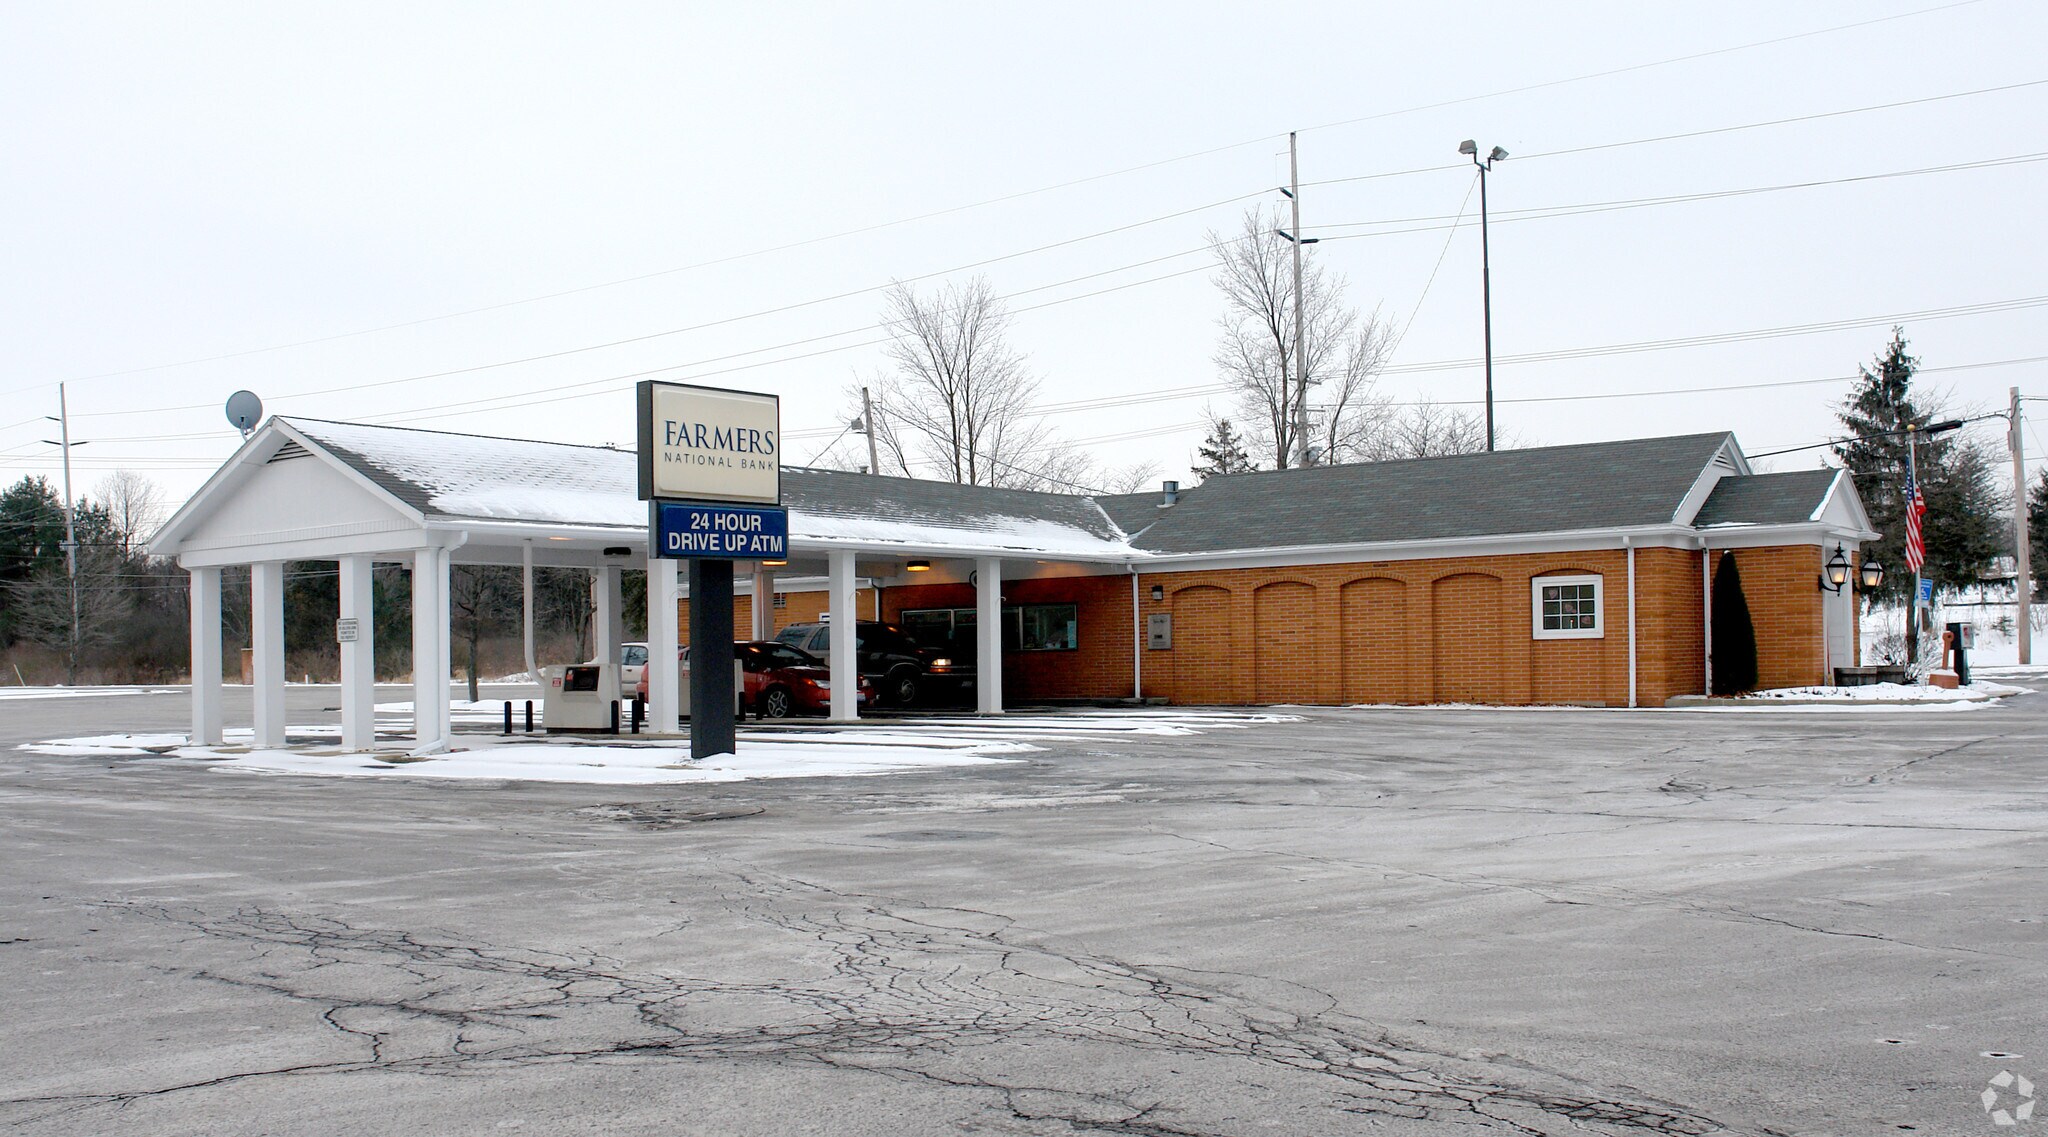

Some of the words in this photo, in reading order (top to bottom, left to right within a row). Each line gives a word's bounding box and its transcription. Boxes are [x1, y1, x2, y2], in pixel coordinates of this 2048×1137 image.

[664, 420, 774, 455] FARMERS
[664, 452, 732, 468] NATIONAL
[741, 458, 774, 471] BANK
[690, 512, 710, 530] 24
[714, 513, 762, 532] HOUR
[668, 532, 720, 551] DRIVE
[725, 534, 747, 552] UP
[750, 535, 783, 552] ATM
